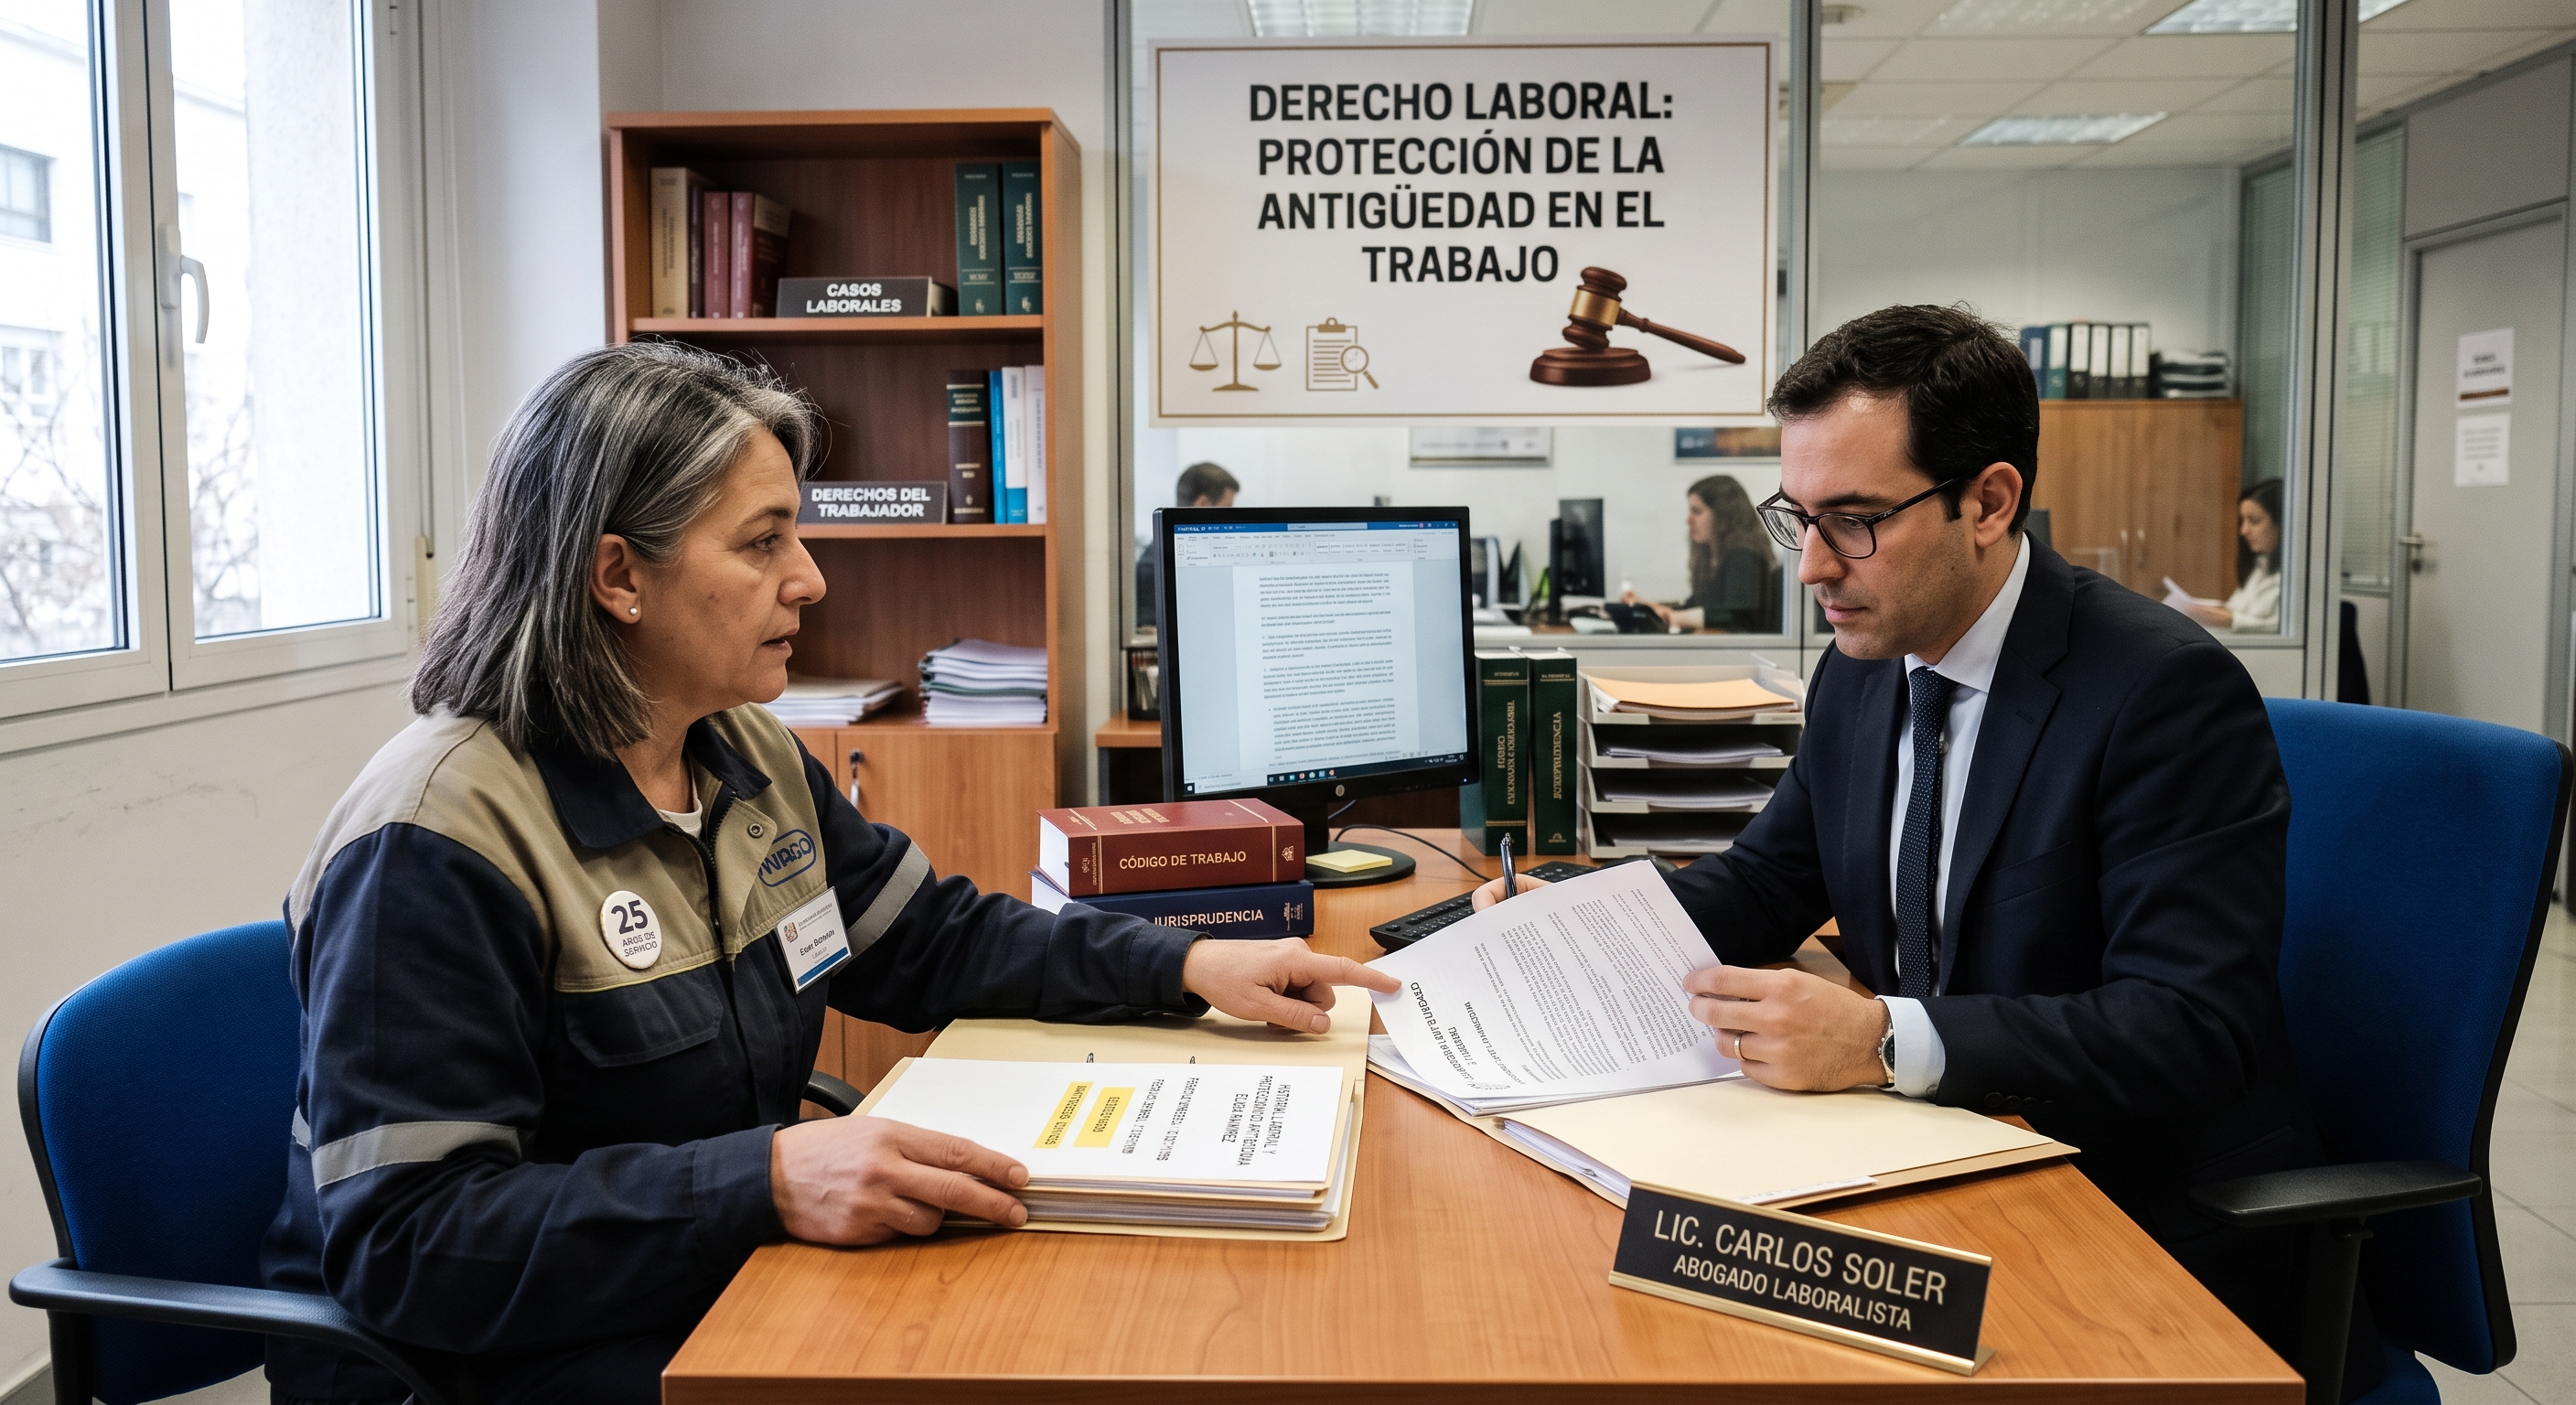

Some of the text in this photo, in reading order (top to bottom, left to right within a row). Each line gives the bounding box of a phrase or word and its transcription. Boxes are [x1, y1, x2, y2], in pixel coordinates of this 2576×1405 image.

[1250, 80, 1673, 122] DERECHO LABORAL:
[1259, 128, 1665, 176] PROTECCIÓN DE LA
[1258, 184, 1665, 230] ANTIGÜEDAD EN EL
[1361, 245, 1559, 283] TRABAJO
[806, 298, 902, 314] LABORALES
[826, 283, 882, 297] CASOS
[810, 487, 931, 502] DERECHOS DEL
[817, 502, 925, 518] TRABAJADOR
[1119, 851, 1247, 869] CÓDIGO DE TRABAJO
[610, 899, 649, 935] 25
[1653, 1209, 1948, 1305] LIC. CARLOS SOLER
[1672, 1253, 1913, 1332] ABOGADO LABORALISTA
